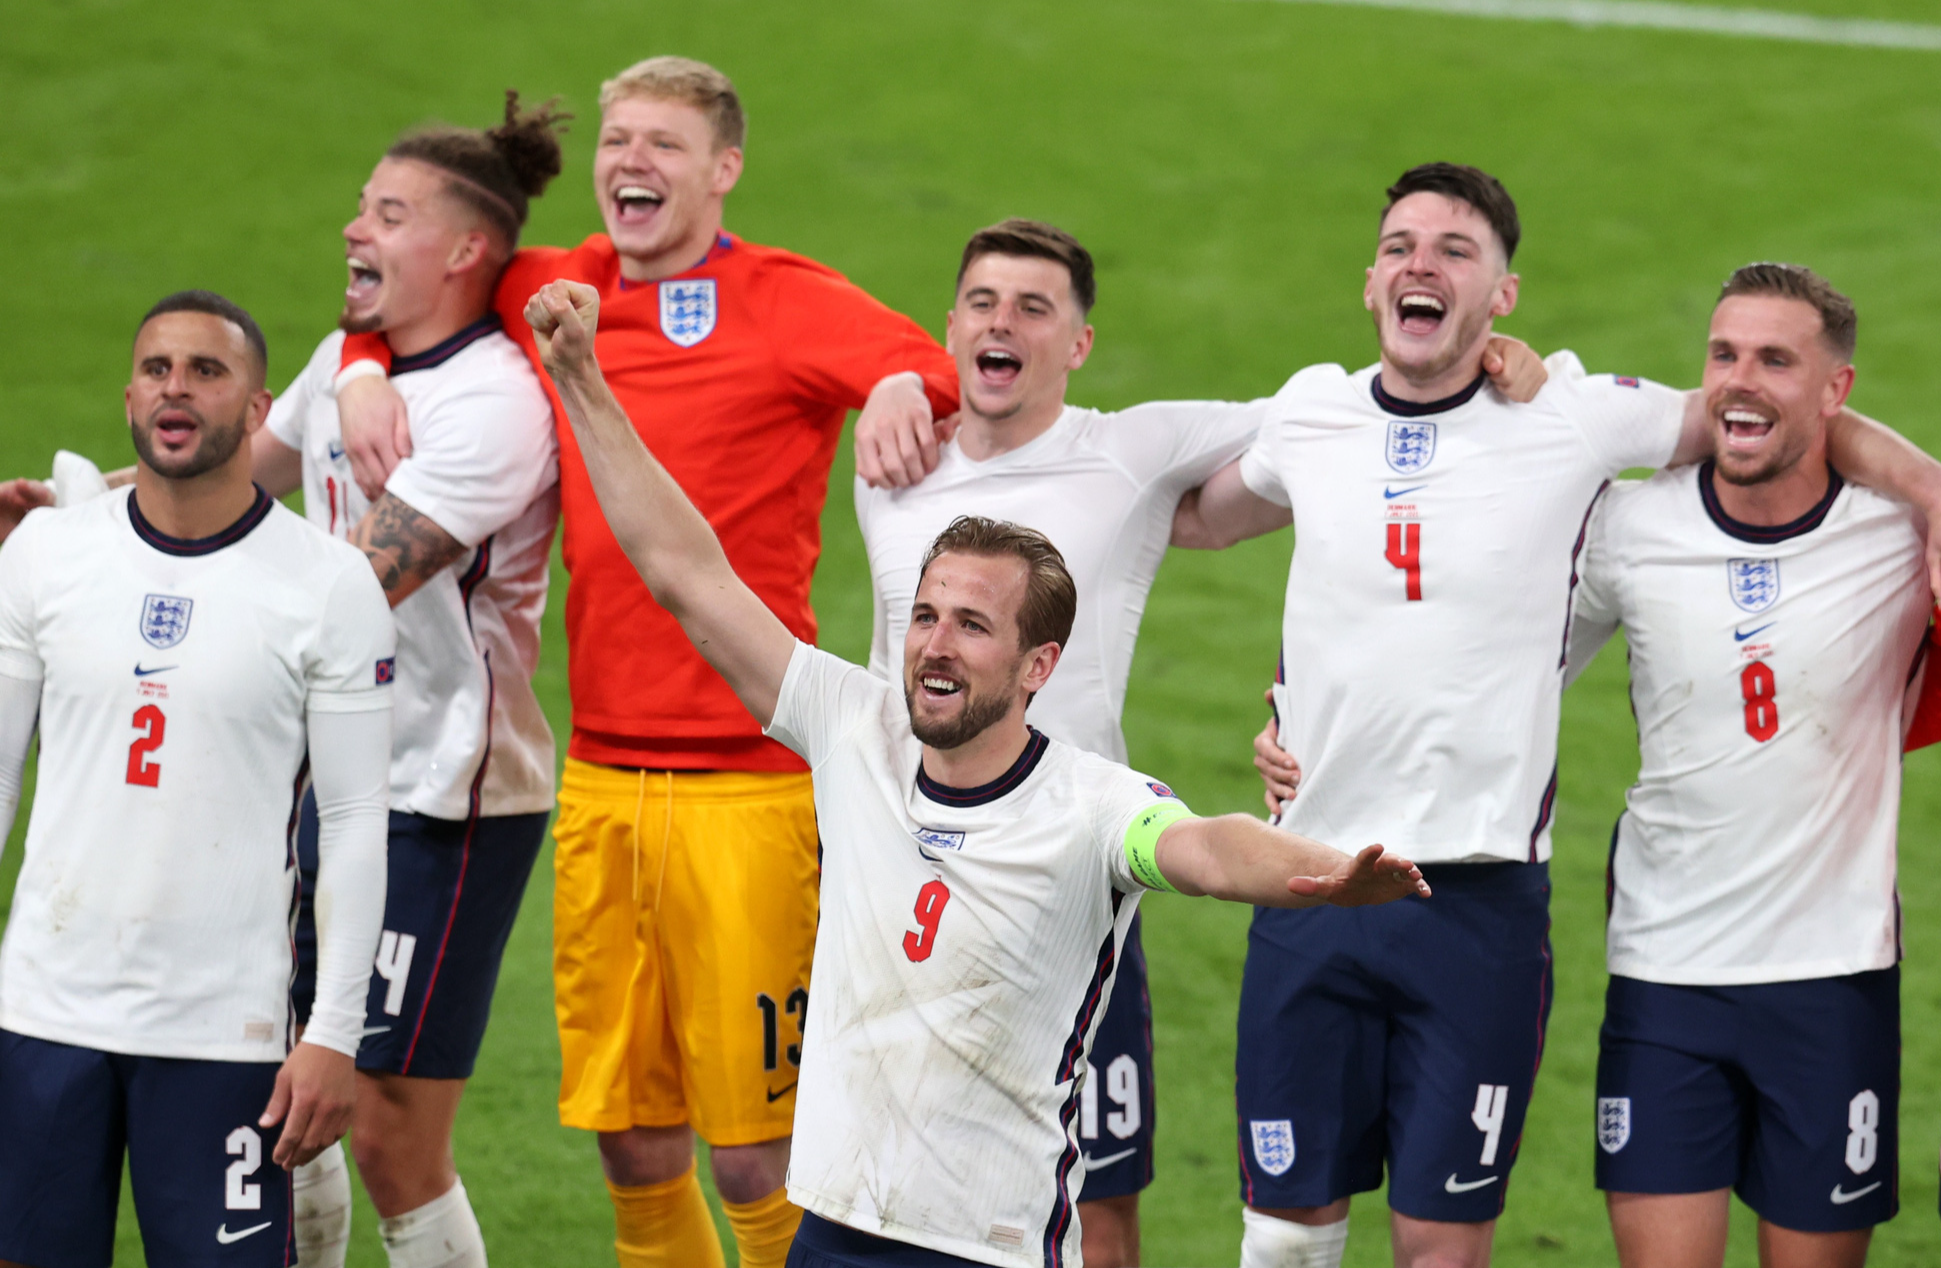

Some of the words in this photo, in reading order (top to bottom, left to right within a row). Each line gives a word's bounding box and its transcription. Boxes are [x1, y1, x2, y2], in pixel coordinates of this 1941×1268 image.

[1385, 523, 1422, 601] 4
[1741, 661, 1779, 742] 8
[126, 704, 166, 788] 2
[902, 880, 951, 963] 9
[375, 929, 417, 1017] 4
[757, 986, 809, 1071] 13
[1081, 1053, 1141, 1139] 19
[1471, 1083, 1509, 1166] 4
[1845, 1089, 1879, 1175] 8
[225, 1125, 262, 1209] 2
